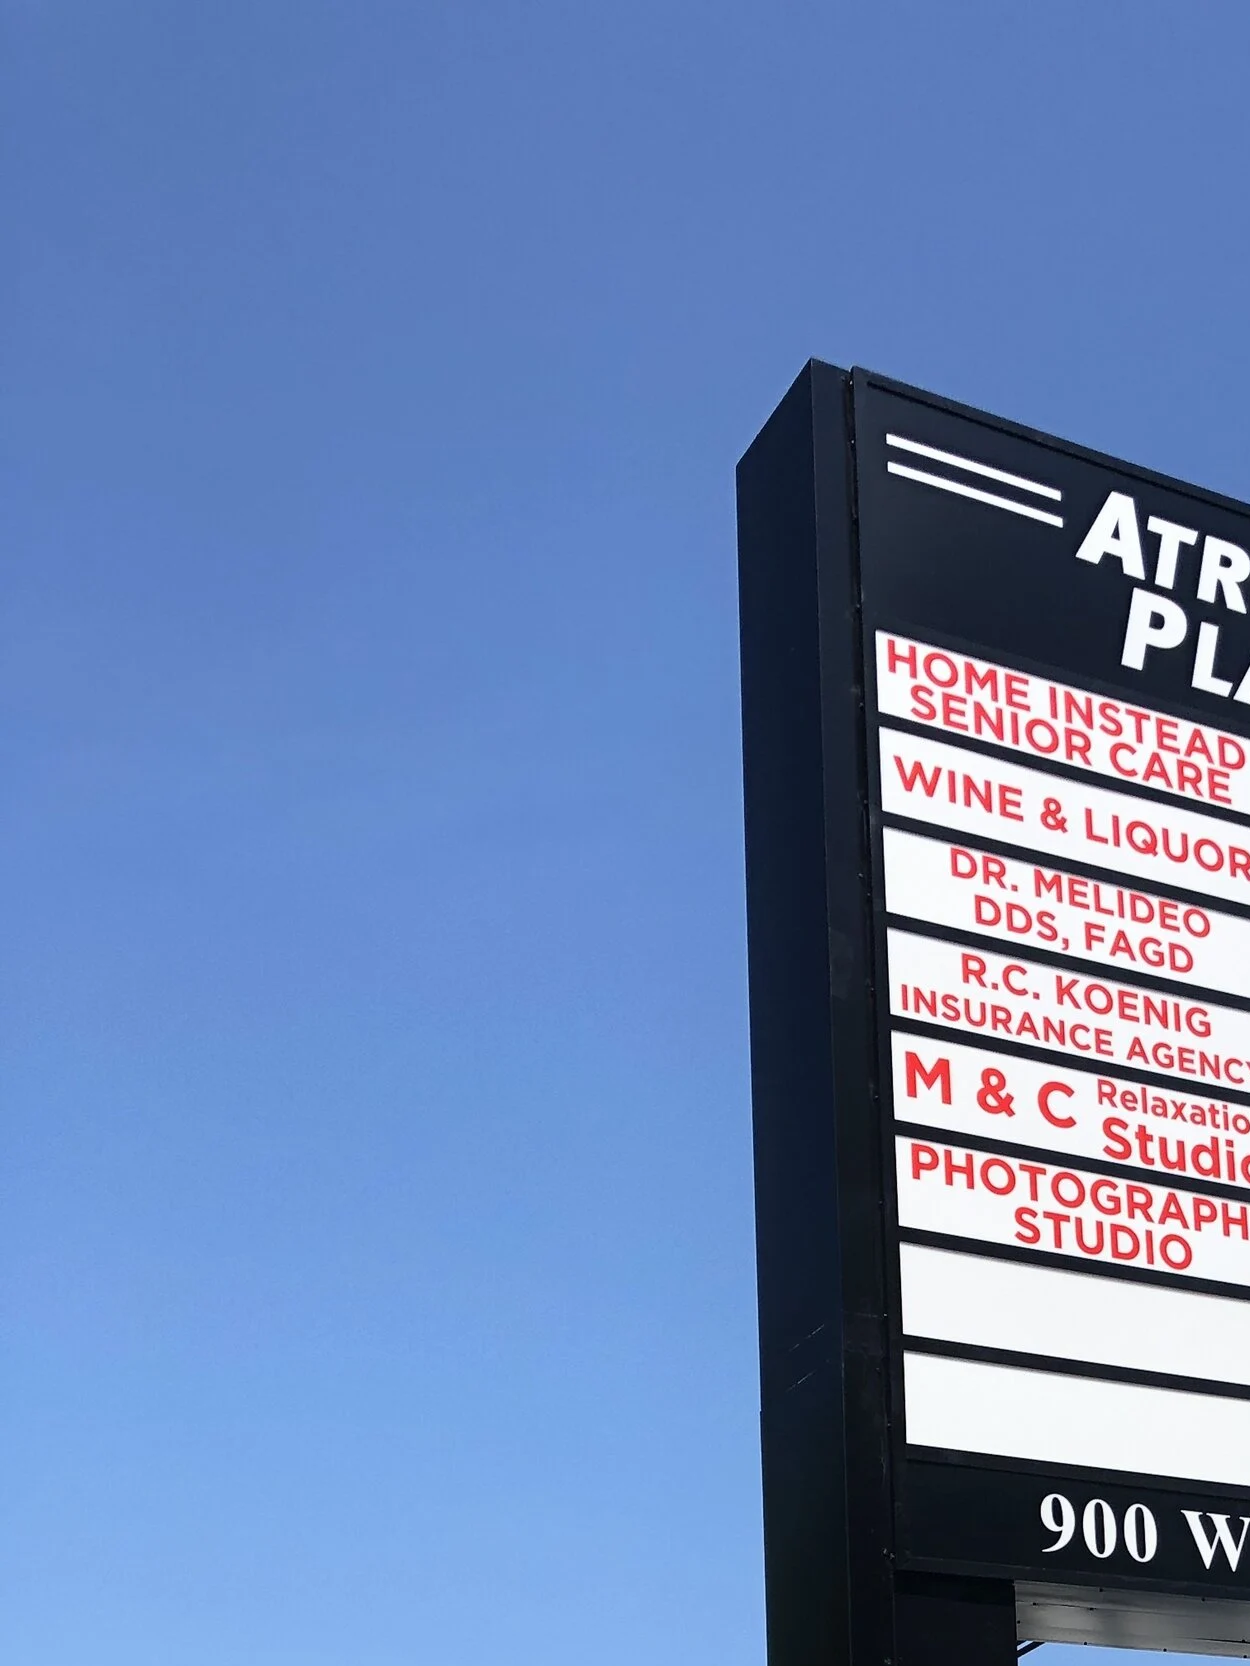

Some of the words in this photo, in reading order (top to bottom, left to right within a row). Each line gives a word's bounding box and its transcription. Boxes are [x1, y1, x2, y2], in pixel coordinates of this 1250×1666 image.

[887, 639, 1031, 712] HOME
[1049, 686, 1246, 771] INSTEAD
[910, 684, 1092, 766] SENIOR
[1109, 741, 1232, 804] CARE
[894, 755, 1024, 822] WINE
[1040, 797, 1068, 833] &
[950, 847, 1018, 892] DR.
[1033, 867, 1211, 938] MELIDEO
[974, 894, 1070, 951] DDS,
[1084, 921, 1194, 973] FAGD
[901, 984, 1114, 1057] INSURANCE
[961, 953, 1040, 1000] R.C.
[1055, 975, 1212, 1039] KOENIG
[905, 1051, 952, 1105] M
[976, 1067, 1017, 1117] &
[1037, 1080, 1077, 1129] C
[1014, 1206, 1193, 1271] STUDIO
[1040, 1492, 1158, 1564] 900
